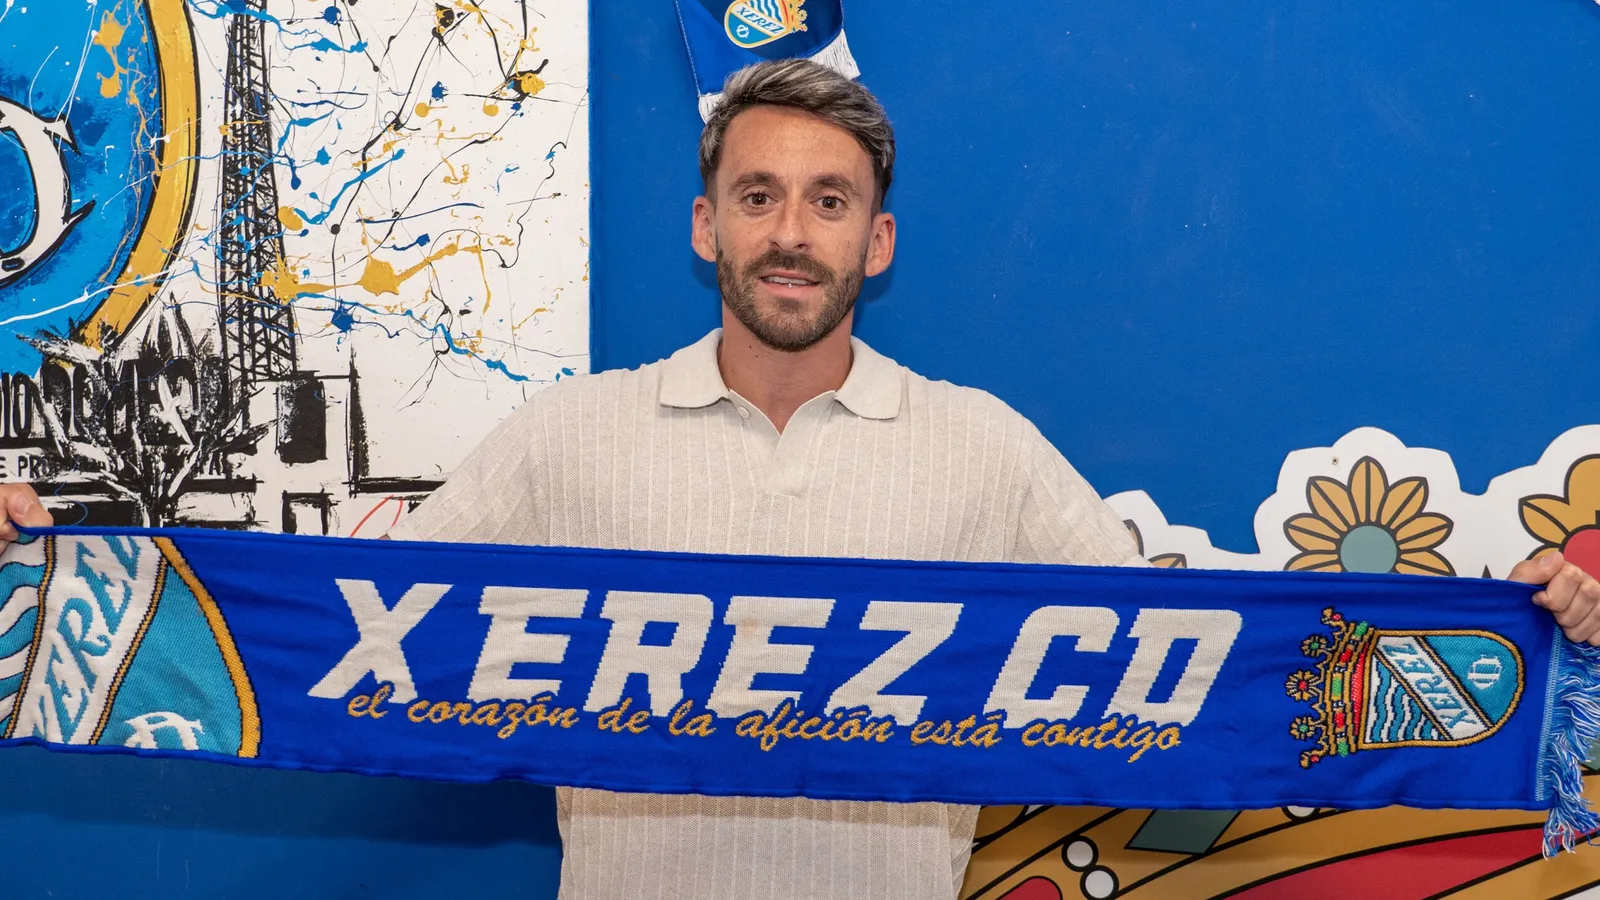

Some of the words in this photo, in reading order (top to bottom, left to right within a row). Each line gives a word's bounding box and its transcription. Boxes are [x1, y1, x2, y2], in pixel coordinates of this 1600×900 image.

[737, 6, 784, 34] XEREZ
[308, 578, 964, 726] XEREZ
[983, 605, 1243, 728] CD
[1382, 642, 1478, 730] XEREZ
[347, 684, 389, 719] el
[407, 695, 580, 739] corazón
[598, 698, 650, 734] de
[668, 699, 716, 737] la
[736, 702, 894, 752] afición
[910, 714, 1002, 748] está
[1021, 717, 1182, 763] contigo
